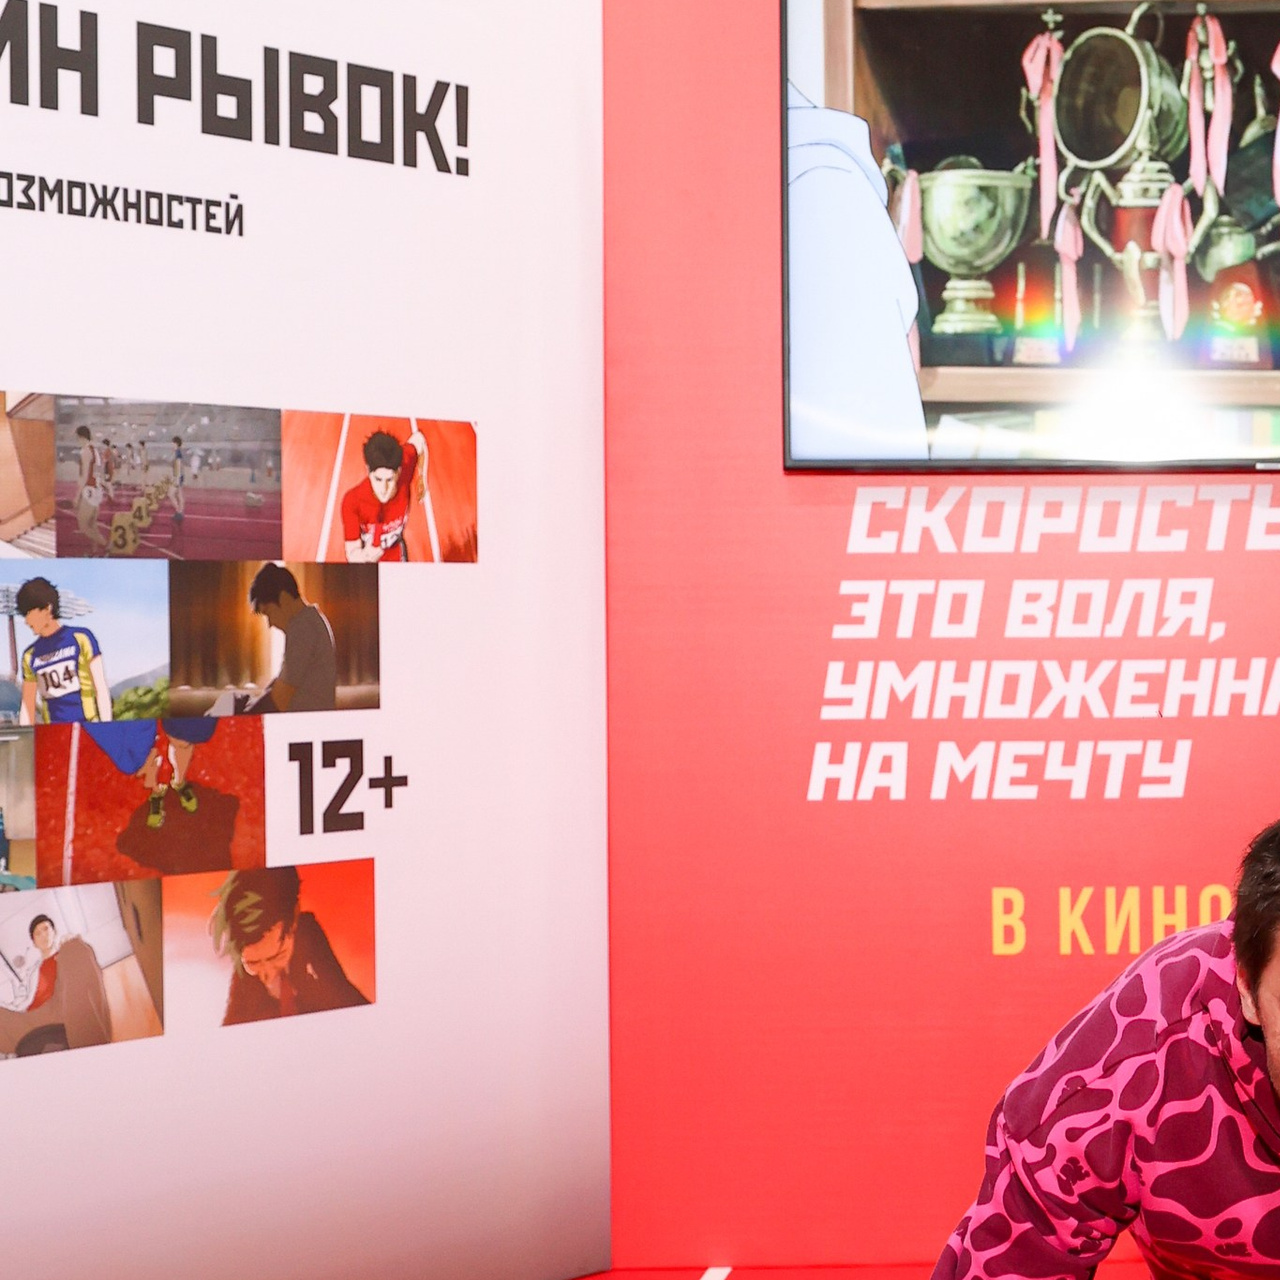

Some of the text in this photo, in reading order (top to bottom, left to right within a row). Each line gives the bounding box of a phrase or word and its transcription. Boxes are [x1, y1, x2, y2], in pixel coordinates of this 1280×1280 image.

[136, 20, 470, 177] РЫВОК!
[831, 577, 1227, 644] ЭТО ВОЛЯ,
[287, 738, 409, 836] 12+
[807, 739, 1193, 801] НА МЕЧТУ
[991, 886, 1027, 956] В
